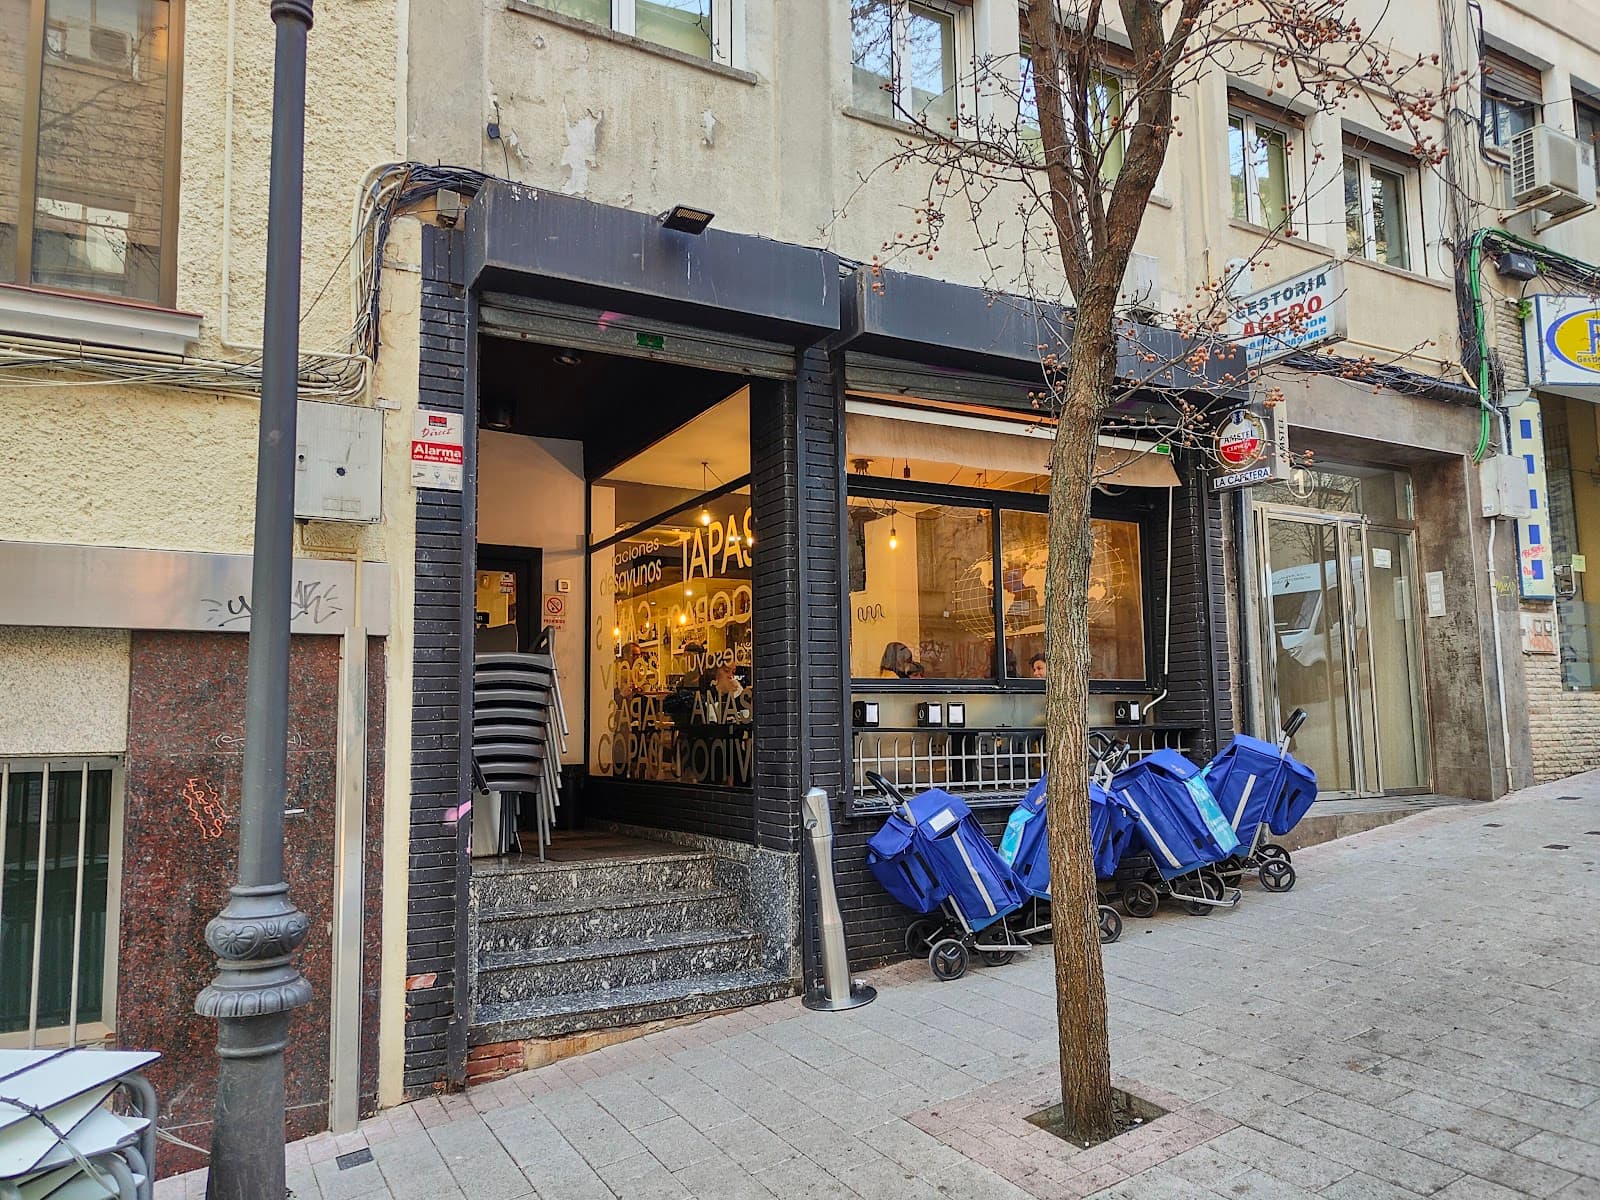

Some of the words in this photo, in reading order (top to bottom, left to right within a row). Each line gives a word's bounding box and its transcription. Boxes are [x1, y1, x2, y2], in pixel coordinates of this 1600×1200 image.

[1224, 429, 1254, 445] AMSTEL
[413, 443, 462, 459] Alarma
[1215, 477, 1227, 489] LA
[611, 537, 660, 565] raciones
[679, 506, 753, 583] TAPAS
[600, 558, 662, 596] desayunos
